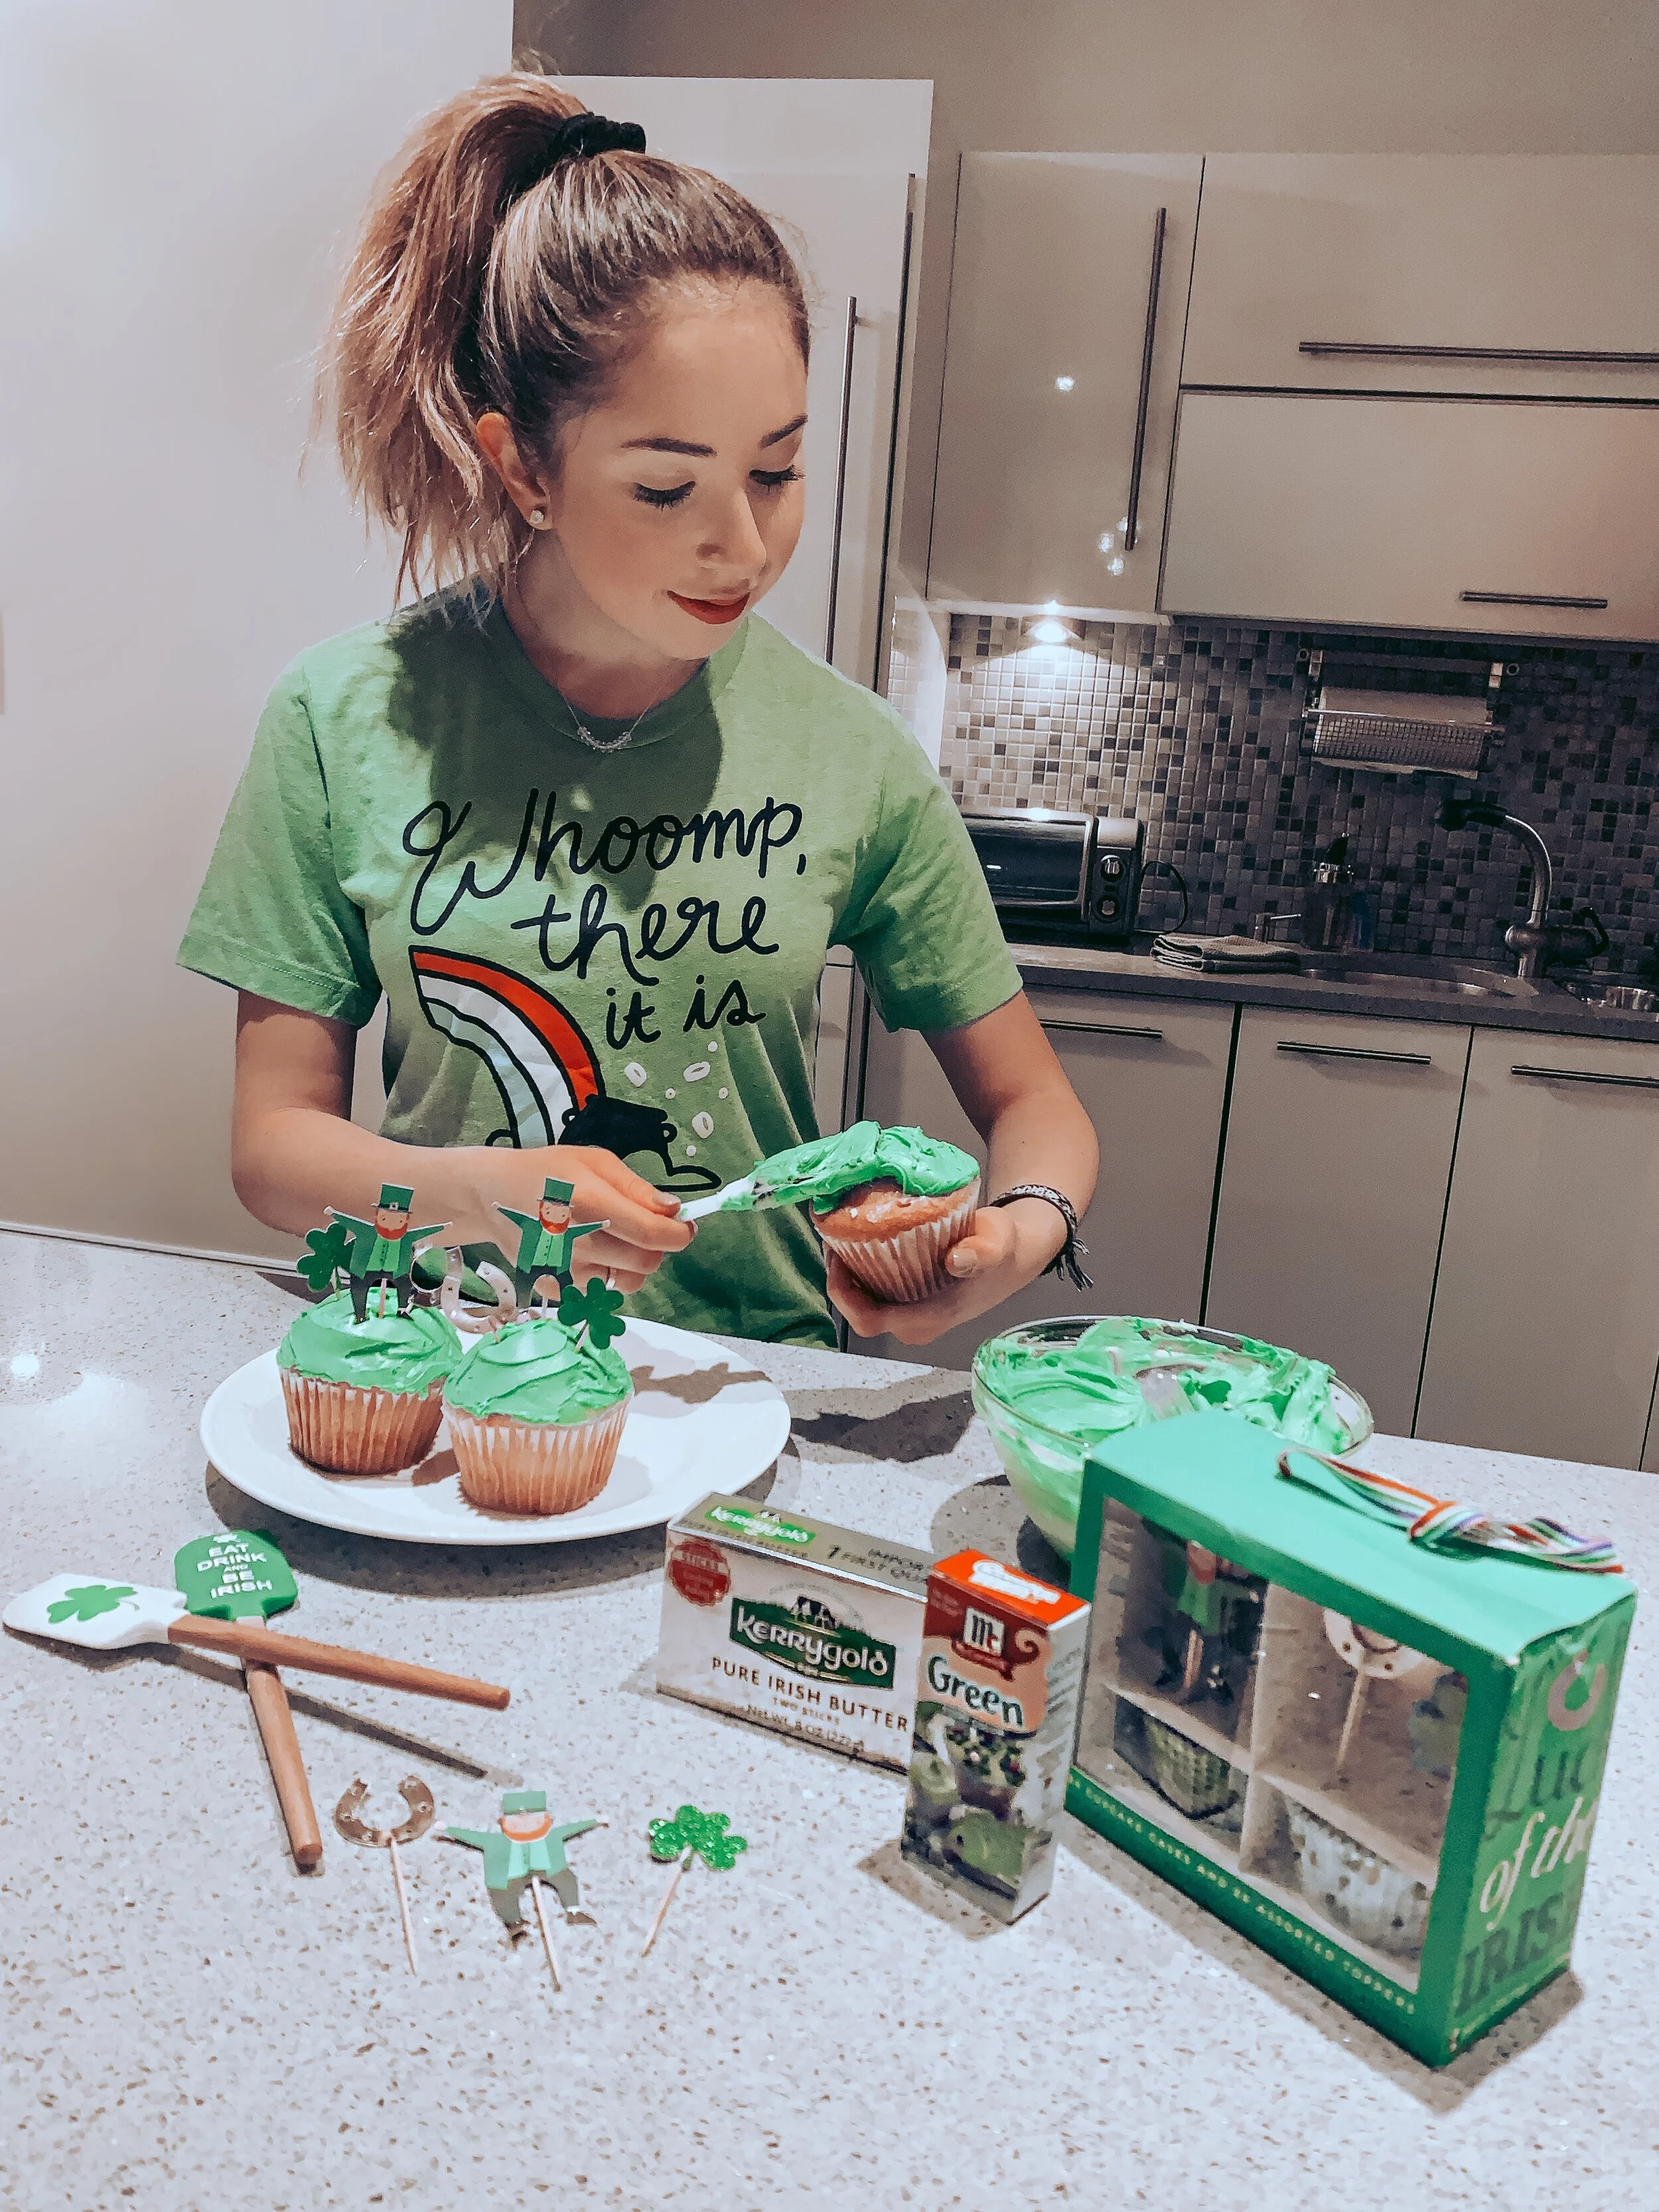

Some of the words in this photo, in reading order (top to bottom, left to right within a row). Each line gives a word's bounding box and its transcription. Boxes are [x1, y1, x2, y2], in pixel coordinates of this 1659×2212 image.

[403, 788, 806, 936] Whoomp,
[510, 883, 779, 988] there
[605, 988, 661, 1050] it
[682, 974, 766, 1032] is
[196, 1552, 267, 1572] DRINK
[208, 1542, 250, 1558] EAT
[222, 1570, 255, 1584] BE
[224, 1563, 249, 1573] AND
[210, 1580, 273, 1599] IRISH
[711, 1656, 760, 1686] PURE
[767, 1674, 822, 1705] IRISH
[829, 1694, 908, 1732] BUTTER
[928, 1656, 1024, 1727] Green
[1480, 1812, 1546, 1931] of
[1454, 1891, 1570, 2018] IRIS
